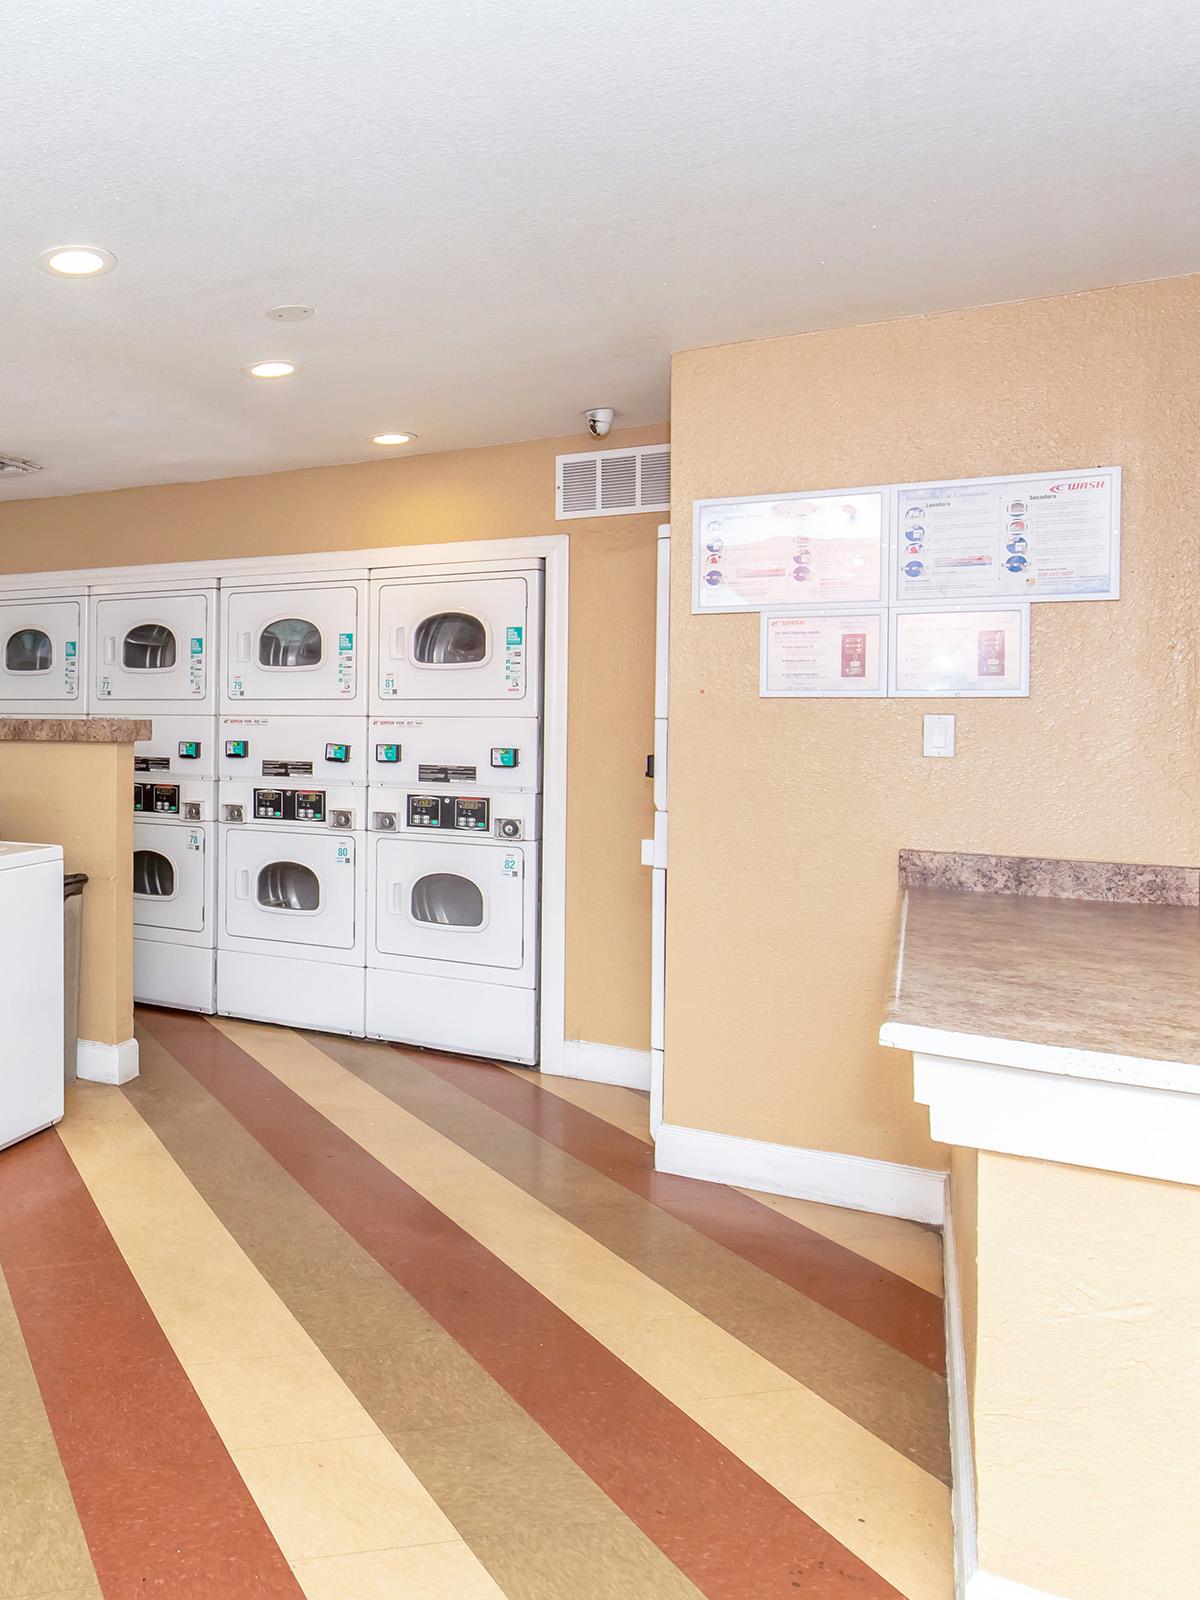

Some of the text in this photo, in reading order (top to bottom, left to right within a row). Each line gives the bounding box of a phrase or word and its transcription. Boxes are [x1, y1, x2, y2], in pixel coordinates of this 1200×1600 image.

[1067, 480, 1105, 491] WASH
[1029, 493, 1057, 501] Secadora
[189, 835, 198, 844] 78
[338, 847, 348, 857] 80
[504, 859, 516, 870] 82
